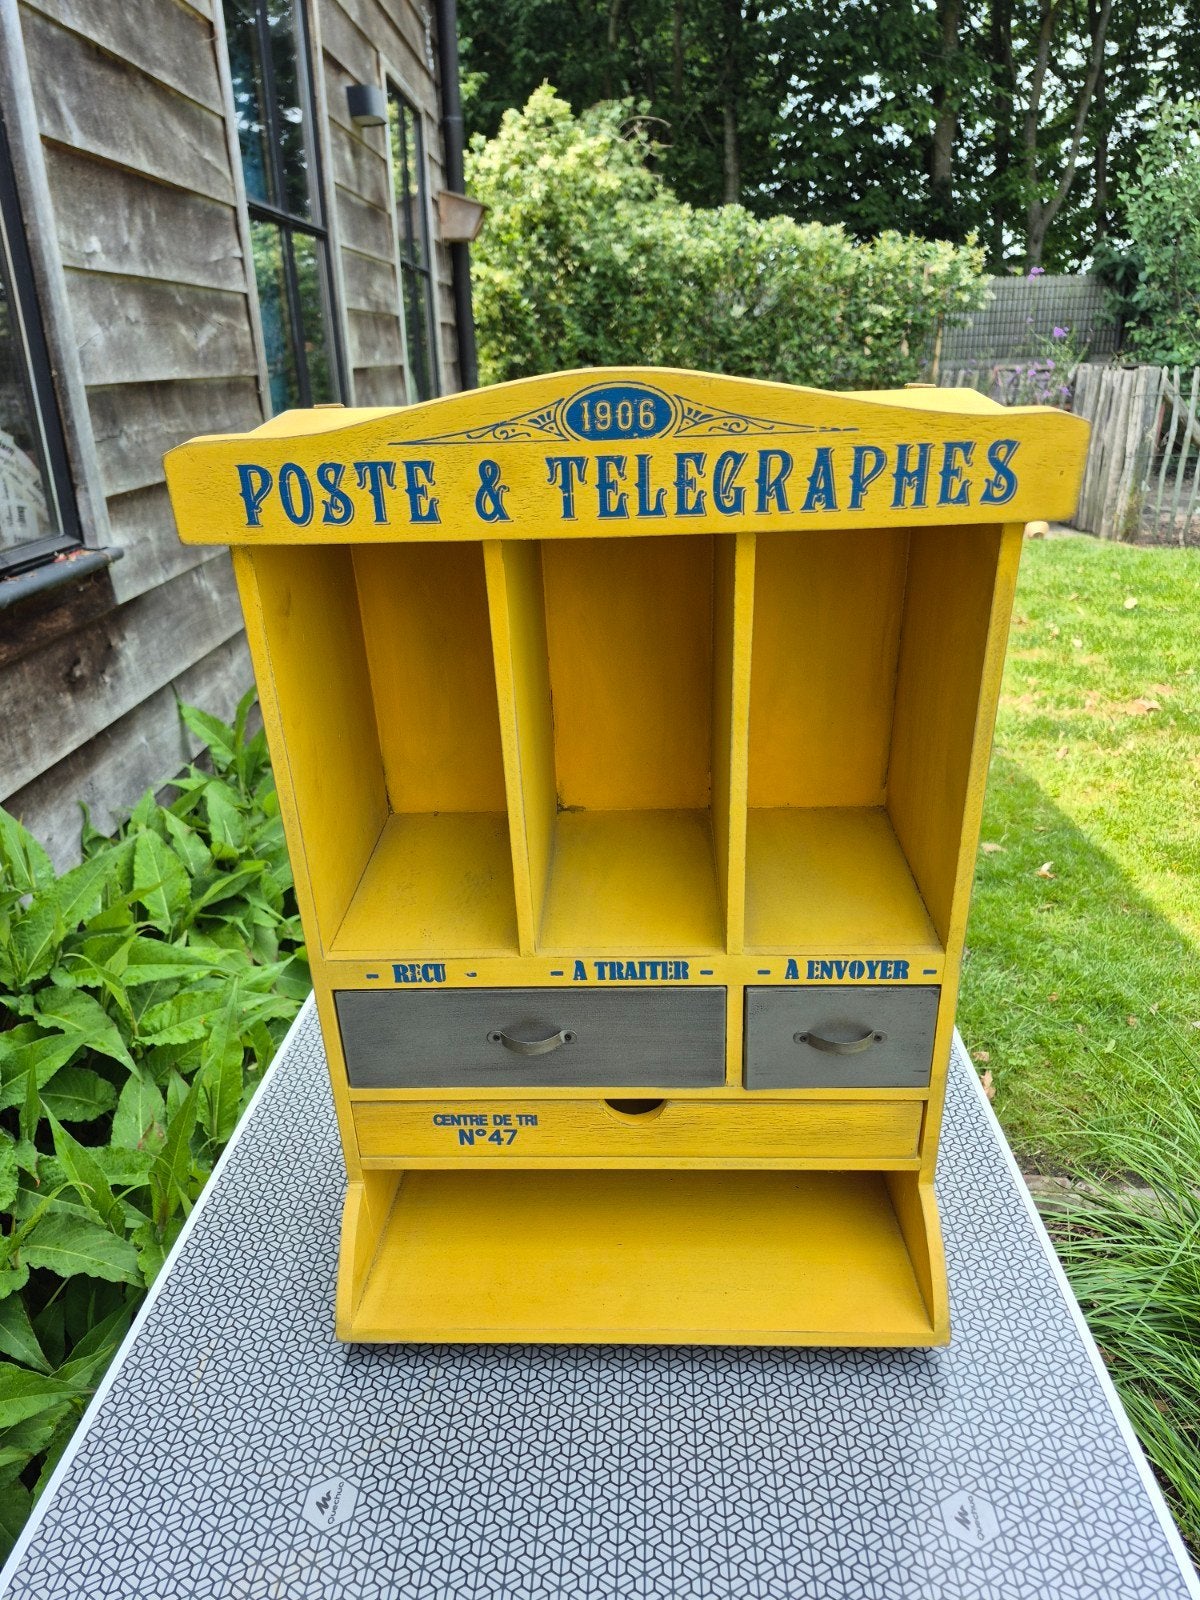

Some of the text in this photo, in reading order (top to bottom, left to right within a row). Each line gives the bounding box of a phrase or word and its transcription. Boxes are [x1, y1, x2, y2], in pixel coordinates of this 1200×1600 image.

[580, 400, 656, 430] 1906
[235, 438, 1021, 528] POSTE & TELEGRAPHES
[392, 963, 446, 983] RECU
[594, 960, 690, 981] TRAITER
[806, 959, 910, 980] ENVOYER
[432, 1114, 538, 1126] CENTRE DE TRI
[328, 1481, 345, 1525] Quechua
